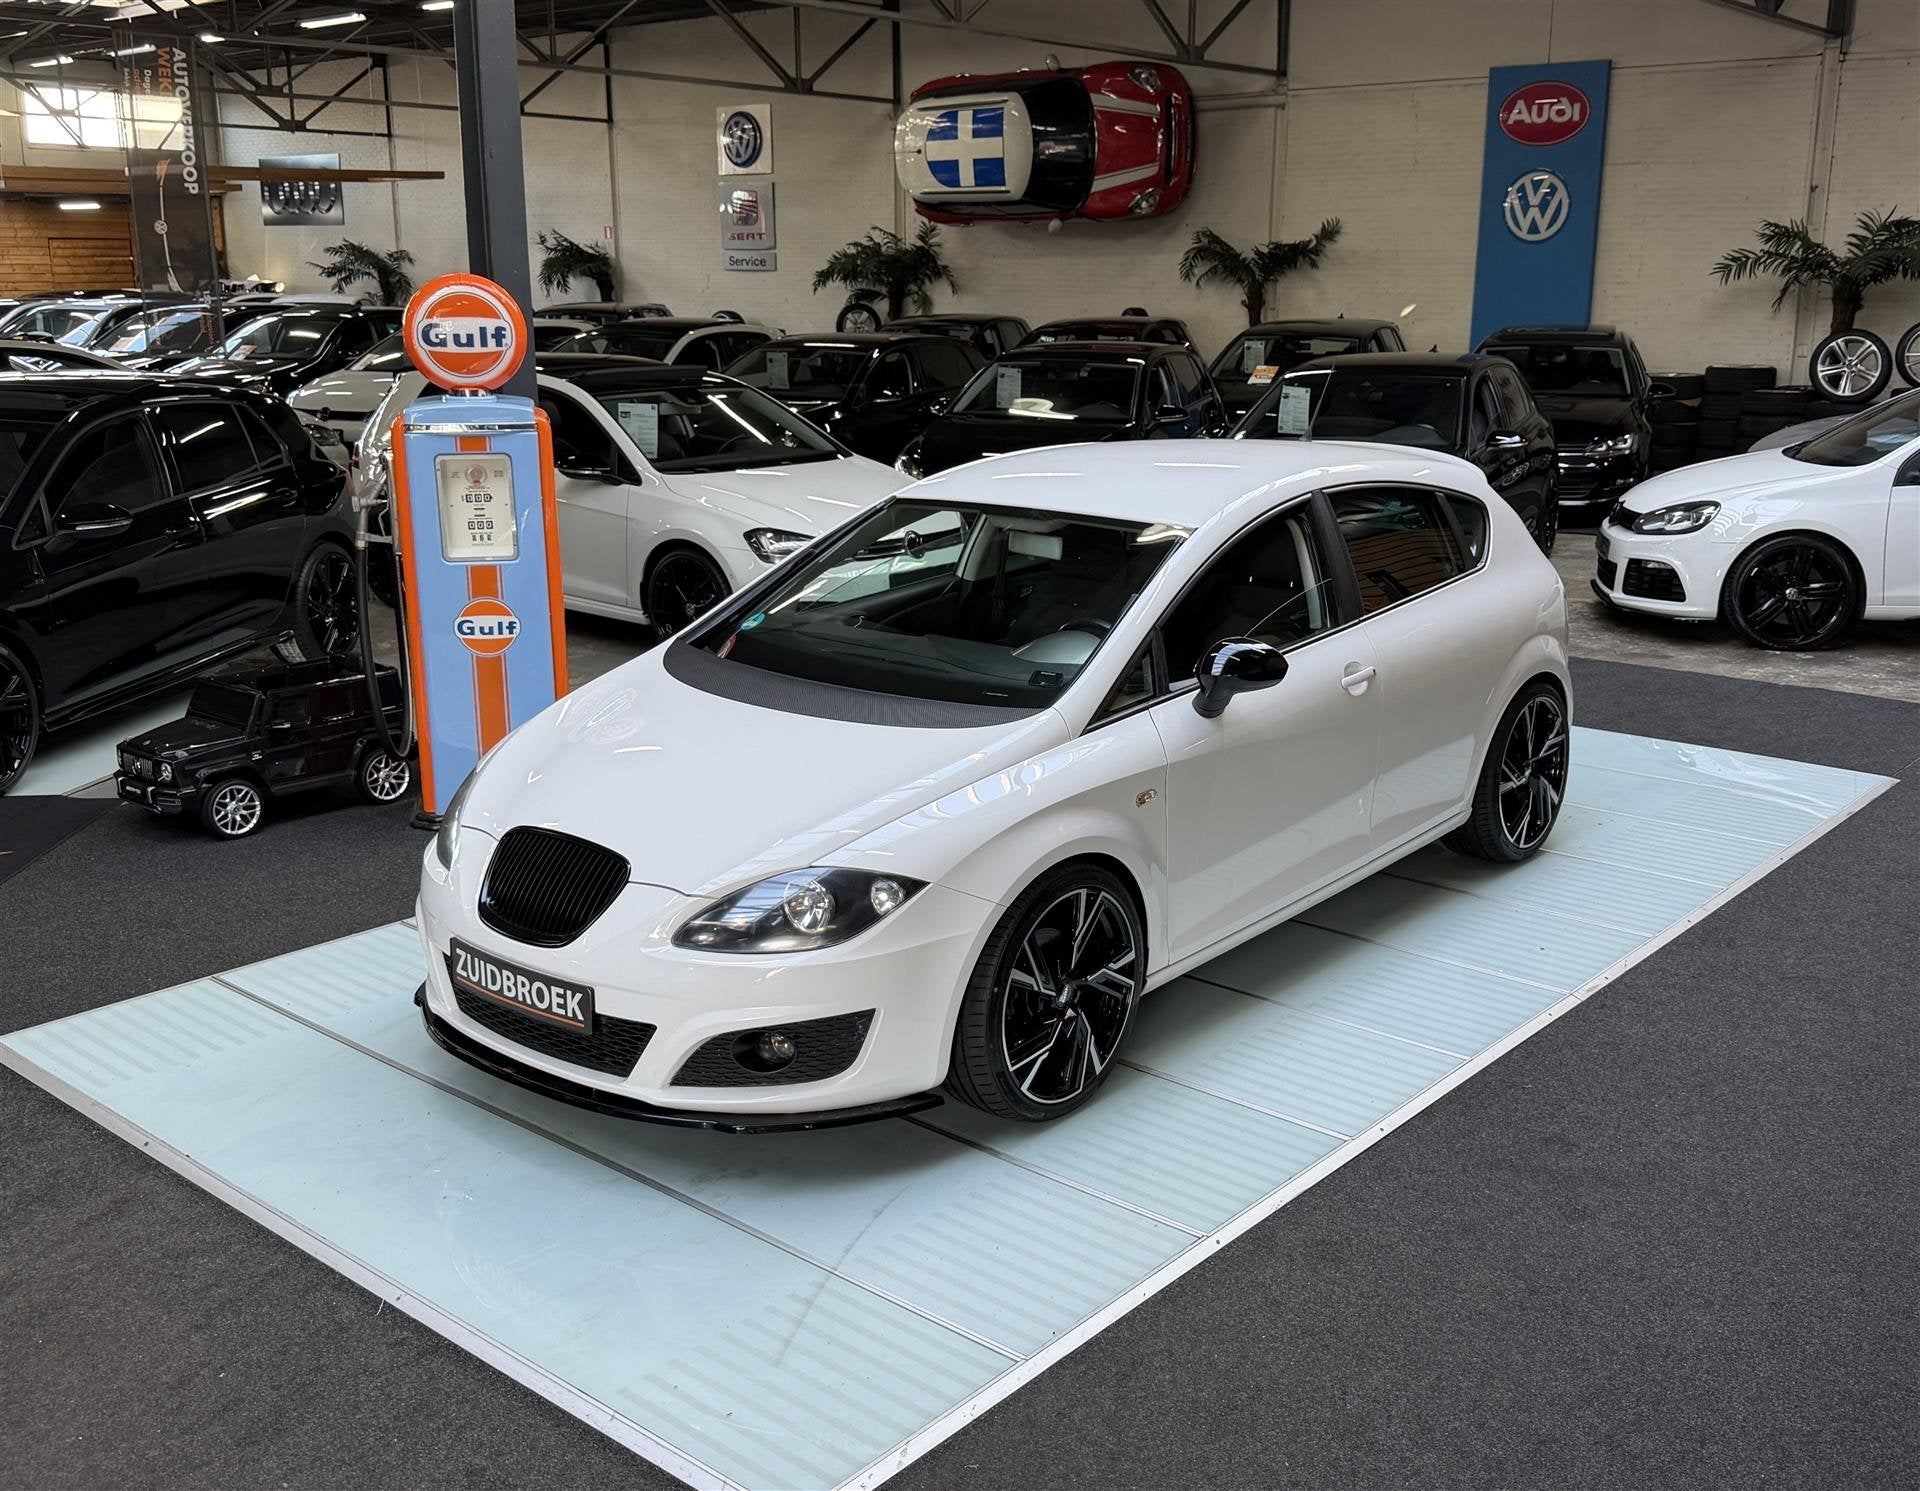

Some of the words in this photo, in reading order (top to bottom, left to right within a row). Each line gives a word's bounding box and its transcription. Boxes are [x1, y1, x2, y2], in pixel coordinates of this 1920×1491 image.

[172, 46, 199, 195] AUTOVERKOOP
[1507, 96, 1581, 125] Audi
[728, 231, 766, 241] SEAT
[728, 255, 767, 267] Service
[421, 322, 507, 348] Gulf
[457, 619, 517, 636] Gulf
[456, 947, 585, 1021] ZUIDBROEK
